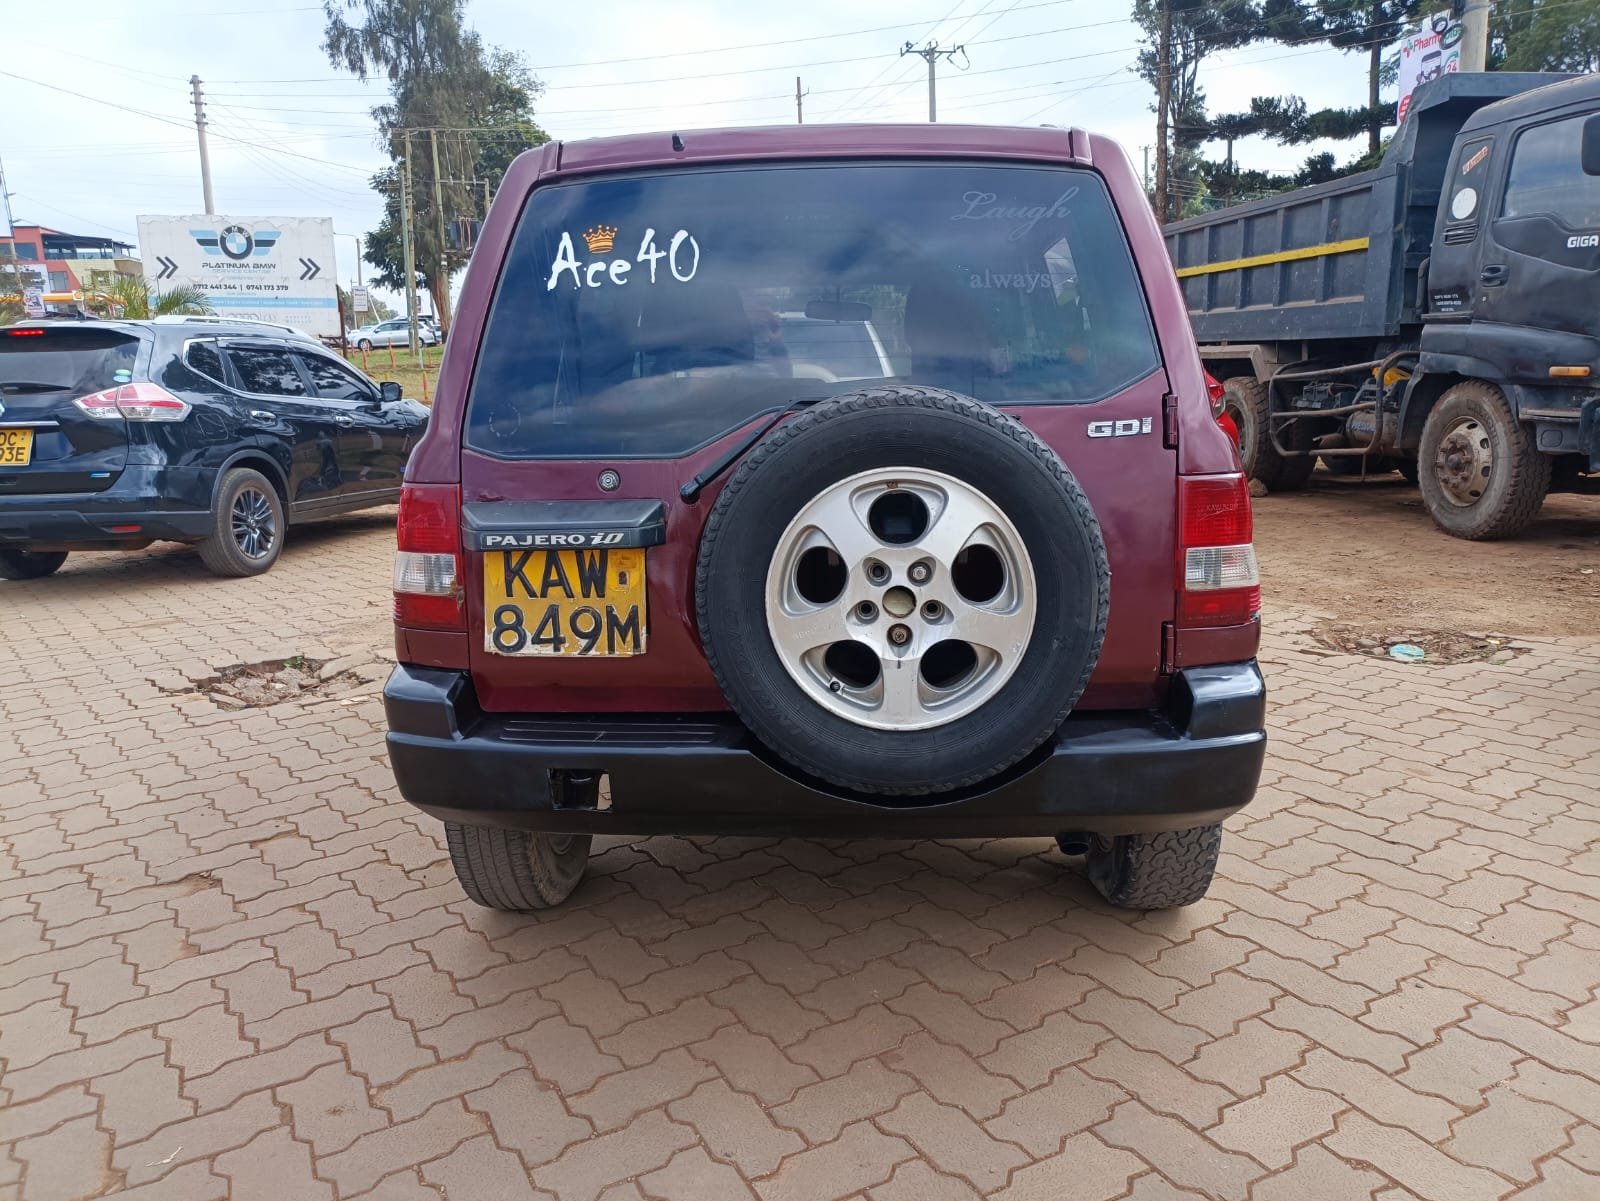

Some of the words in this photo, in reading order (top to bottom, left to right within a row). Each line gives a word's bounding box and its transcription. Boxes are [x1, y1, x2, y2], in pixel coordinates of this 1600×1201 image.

[951, 186, 1080, 242] Laugh
[547, 231, 632, 291] Ace
[636, 228, 700, 284] 40
[1566, 234, 1600, 249] GIGA
[969, 268, 1051, 294] always
[486, 534, 586, 546] PAJERO
[503, 549, 609, 599] KAW
[492, 604, 641, 656] 849M
